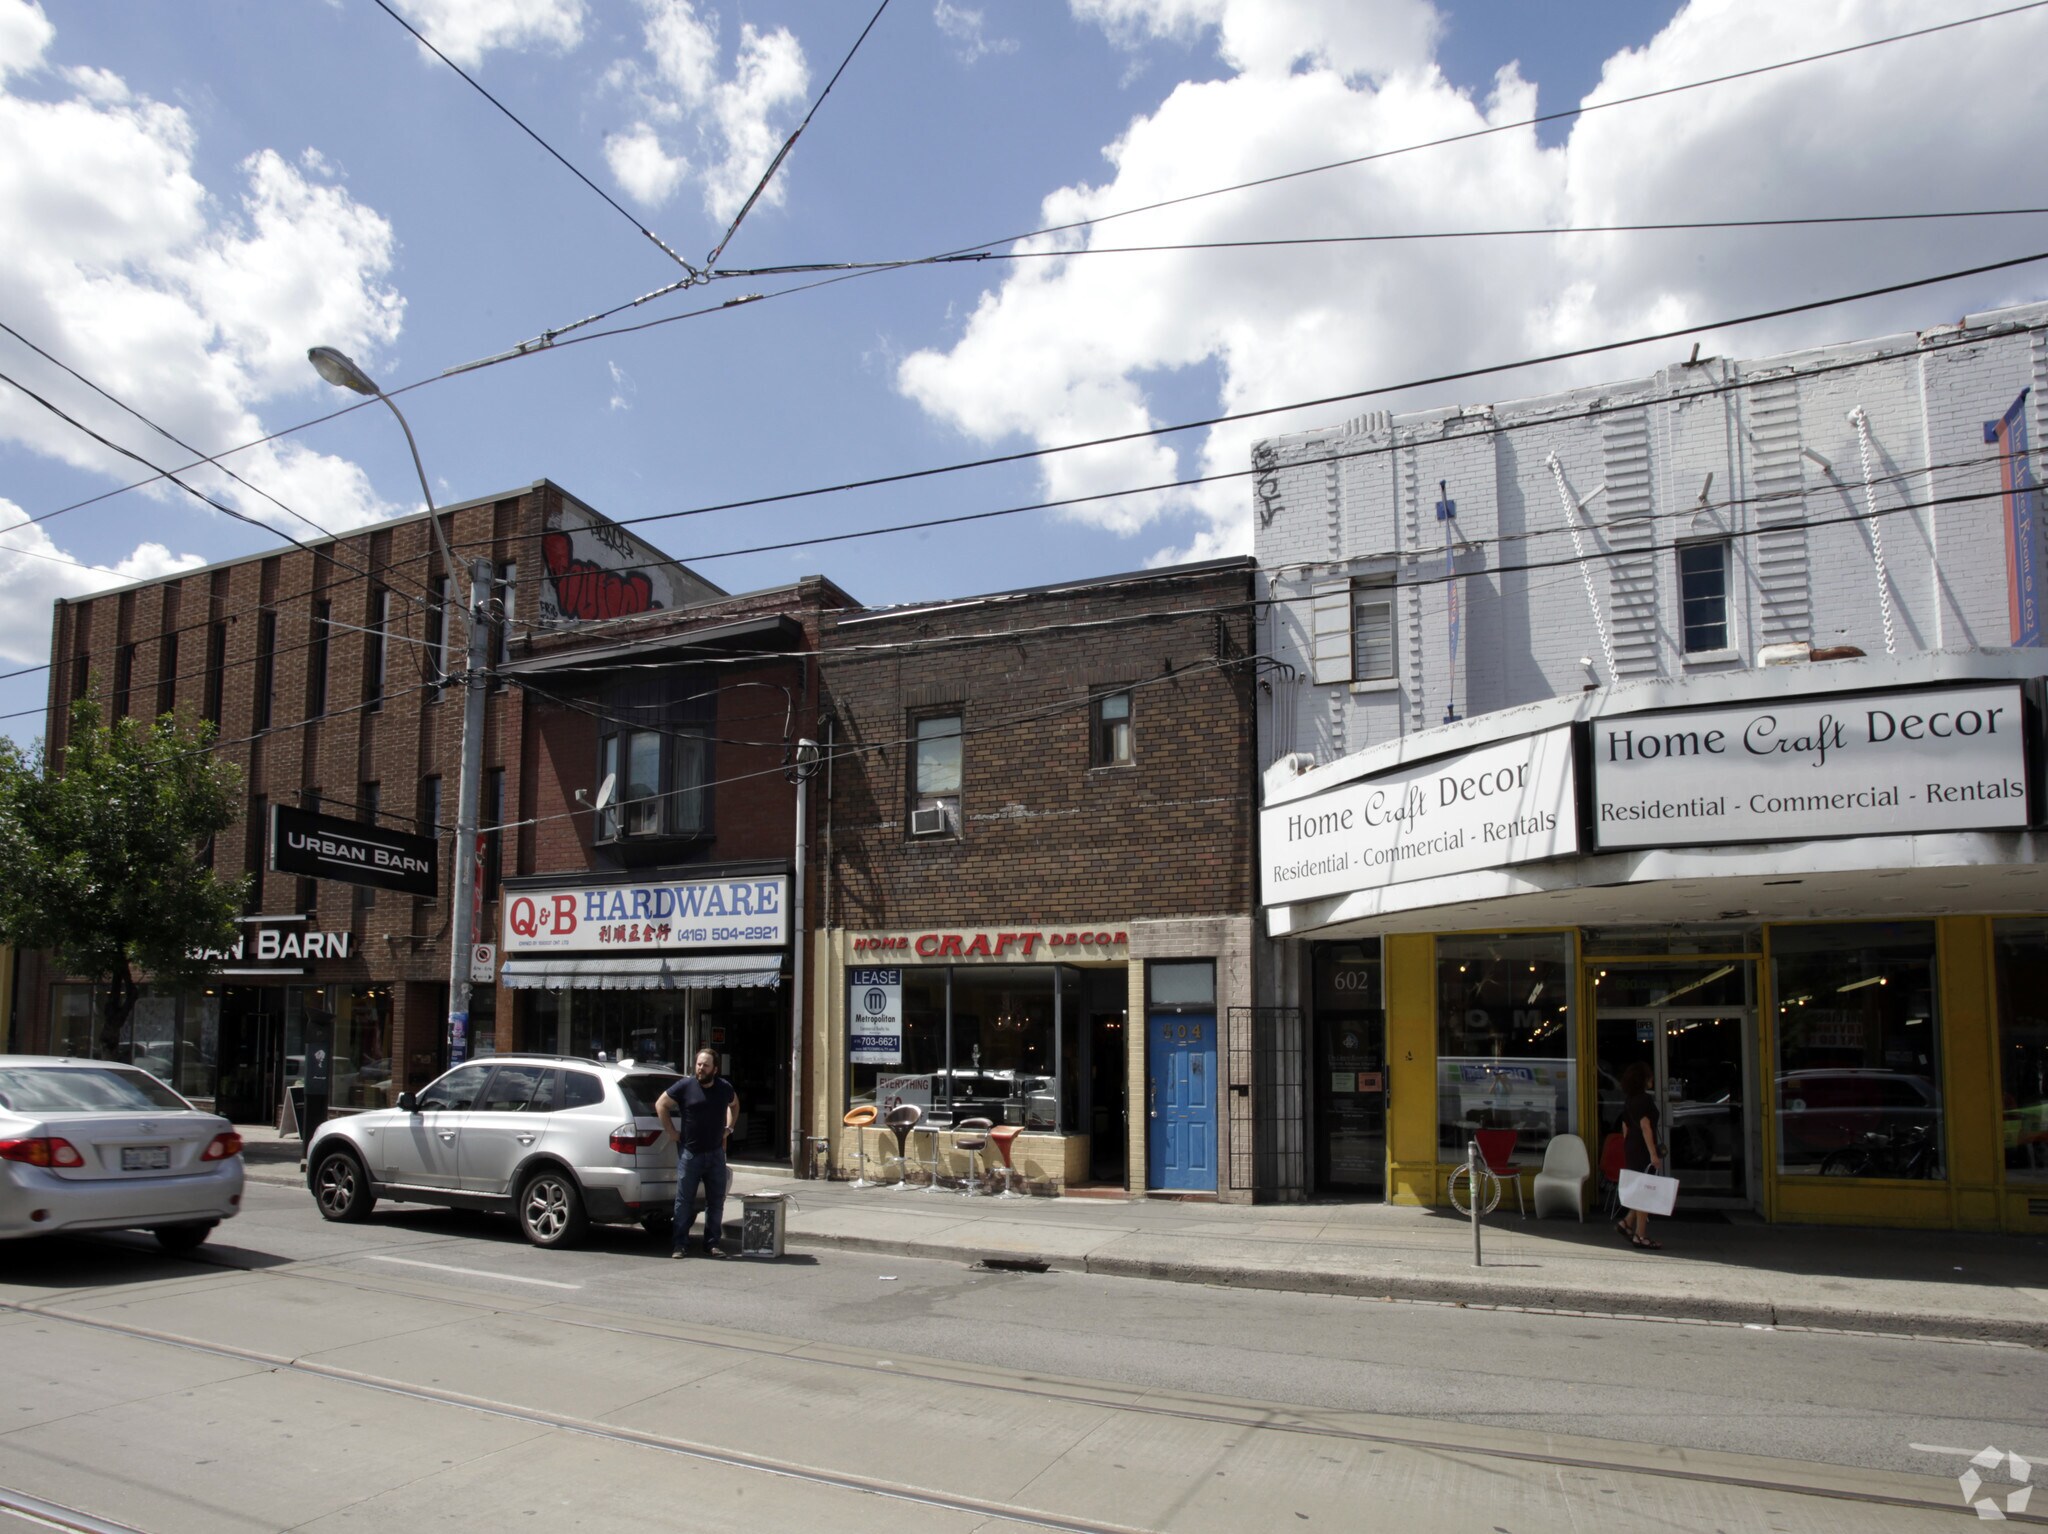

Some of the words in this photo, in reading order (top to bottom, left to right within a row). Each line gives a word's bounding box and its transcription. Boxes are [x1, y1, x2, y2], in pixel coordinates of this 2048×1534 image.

[2010, 414, 2026, 450] The
[2018, 518, 2034, 574] Room
[2024, 575, 2033, 593] @
[2025, 598, 2035, 633] 602
[1608, 729, 1727, 762] Home
[1742, 713, 1848, 768] Craft
[1866, 707, 2005, 744] Decor
[1288, 808, 1354, 842] Home
[1364, 785, 1428, 833] Craft
[1439, 763, 1530, 808] Decor
[1601, 796, 1726, 822] Residential
[1749, 786, 1899, 814] Commercial
[1926, 778, 2024, 804] Rentals
[287, 831, 367, 863] URBAN
[374, 849, 430, 873] BARN
[1273, 852, 1349, 883] Residential
[1363, 828, 1465, 867] Commercial
[1482, 810, 1557, 844] Rentals
[509, 894, 577, 938] Q&B
[583, 881, 779, 921] HARDWARE
[257, 930, 349, 960] BARN
[677, 929, 707, 943] (416)
[711, 926, 779, 941] 504-2921
[853, 937, 908, 951] HOME
[914, 932, 1043, 957] CRAFT
[1048, 931, 1128, 946] DECOR
[854, 971, 897, 985] LEASE
[1334, 971, 1369, 991] 602
[855, 1014, 896, 1025] Metropolitan
[861, 1037, 898, 1046] 703-6621
[879, 1078, 929, 1090] EVERYTHING
